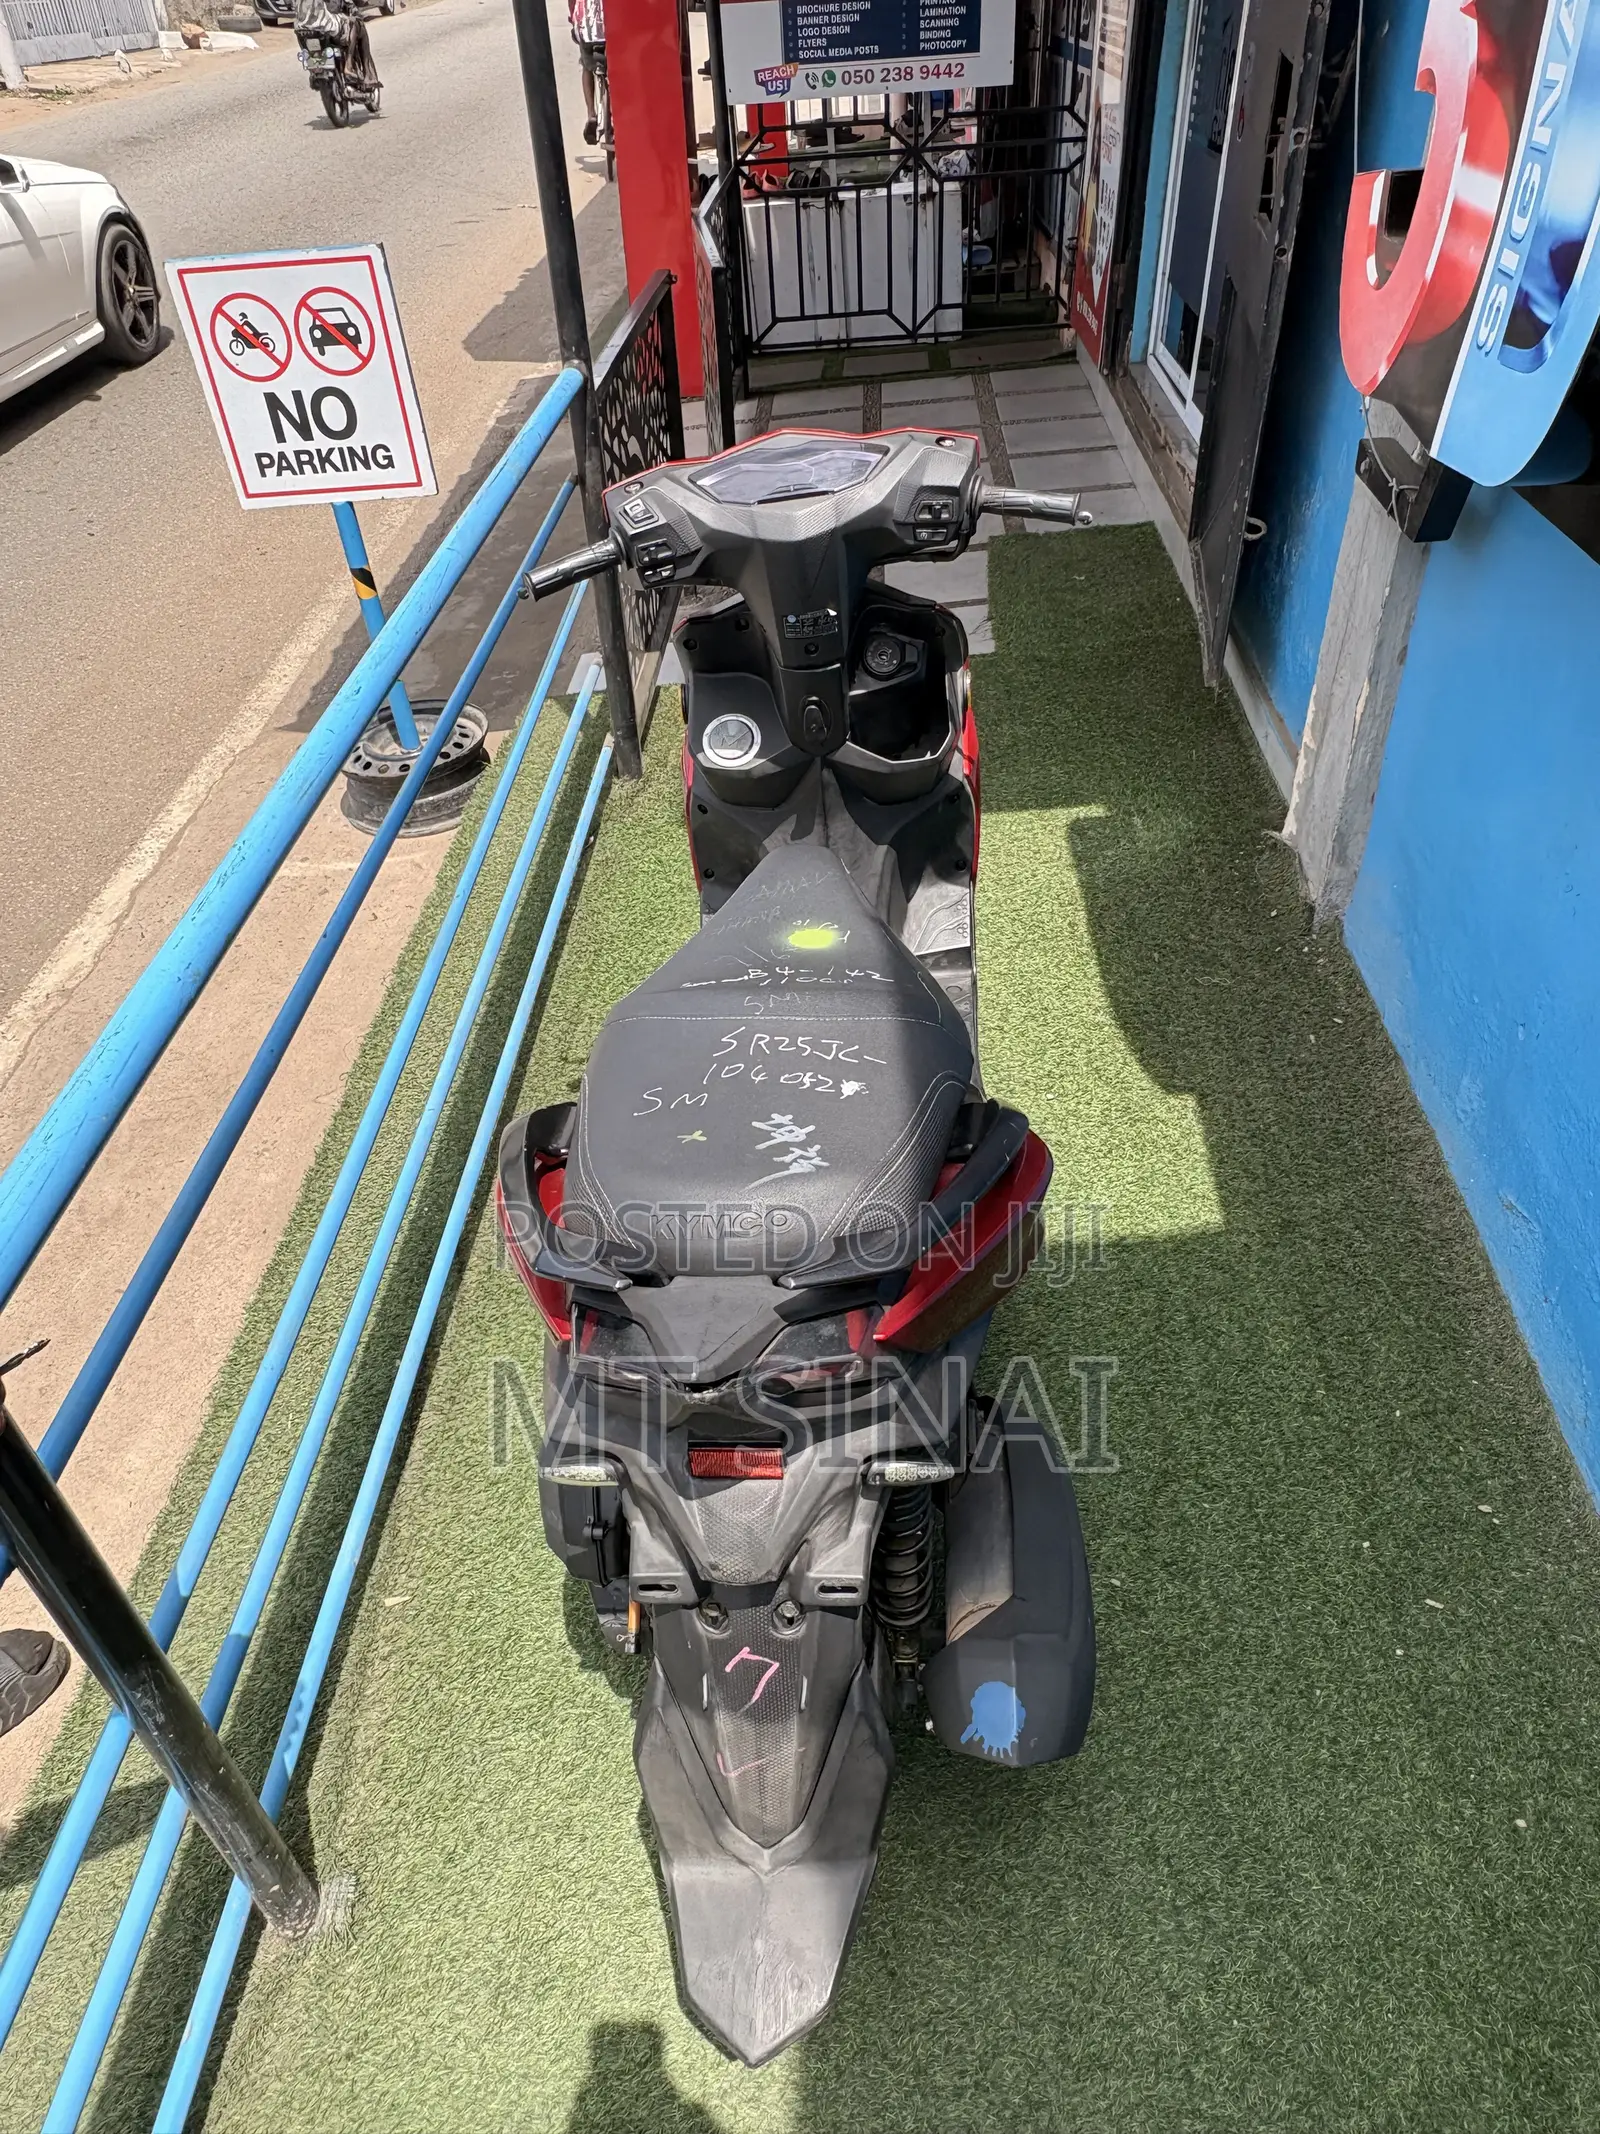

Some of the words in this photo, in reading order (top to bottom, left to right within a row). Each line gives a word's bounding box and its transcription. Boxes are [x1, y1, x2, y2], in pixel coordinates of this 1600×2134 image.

[796, 2, 840, 15] BROCHURE
[841, 1, 871, 11] DESIGN
[919, 5, 967, 17] LAMINATION
[797, 15, 830, 26] BANNER
[831, 13, 860, 24] DESIGN
[919, 17, 960, 28] SCANNING
[797, 27, 820, 37] LOGO
[821, 25, 851, 35] DESIGN
[919, 29, 952, 40] BINDING
[798, 37, 827, 48] FLYERS
[919, 39, 967, 51] PHOTOCOPY
[798, 48, 827, 59] SOCIAL
[828, 46, 853, 57] MEDIA
[854, 45, 880, 55] POSTS
[757, 65, 795, 82] REACH
[841, 69, 875, 86] 050
[880, 66, 914, 83] 238
[919, 62, 966, 80] 9442
[767, 80, 789, 92] US!
[262, 385, 359, 445] NO
[254, 443, 396, 478] PARKING
[650, 1207, 799, 1240] KYMCO
